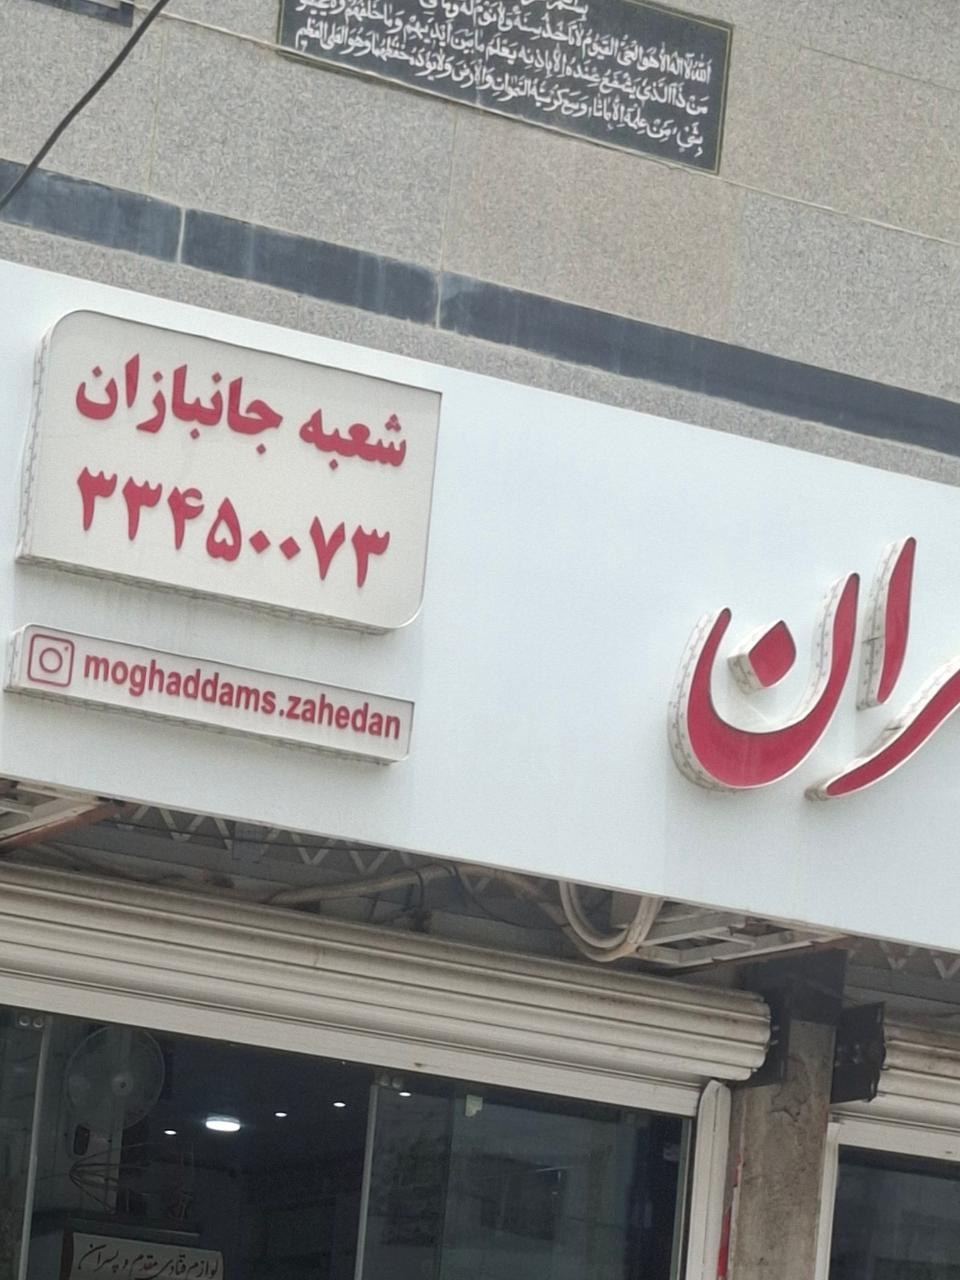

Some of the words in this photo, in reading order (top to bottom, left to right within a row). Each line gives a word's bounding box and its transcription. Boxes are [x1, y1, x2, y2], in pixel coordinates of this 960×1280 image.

[75, 353, 283, 456] جانبازان
[299, 408, 407, 471] شعبه
[77, 466, 391, 589] ۳۳۴۵۰۰۷۳
[84, 651, 401, 740] moghaddams.zahedan
